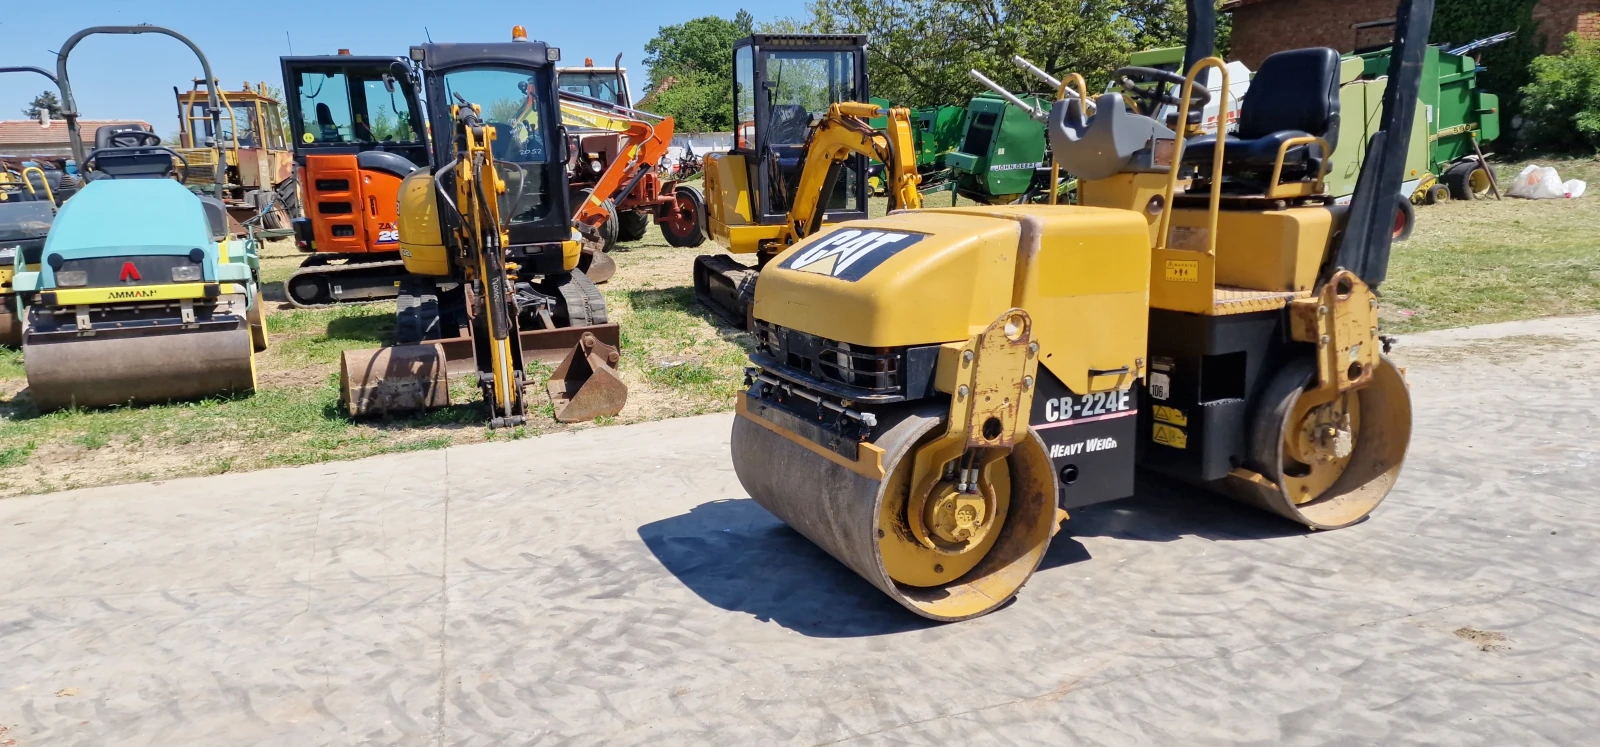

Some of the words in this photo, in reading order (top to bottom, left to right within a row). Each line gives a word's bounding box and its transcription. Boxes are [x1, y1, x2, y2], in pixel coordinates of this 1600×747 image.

[561, 112, 597, 125] ITACHI
[790, 230, 910, 276] CAT
[1151, 384, 1164, 397] 106
[1045, 389, 1130, 422] CB-224E
[1050, 442, 1084, 458] HEAVY
